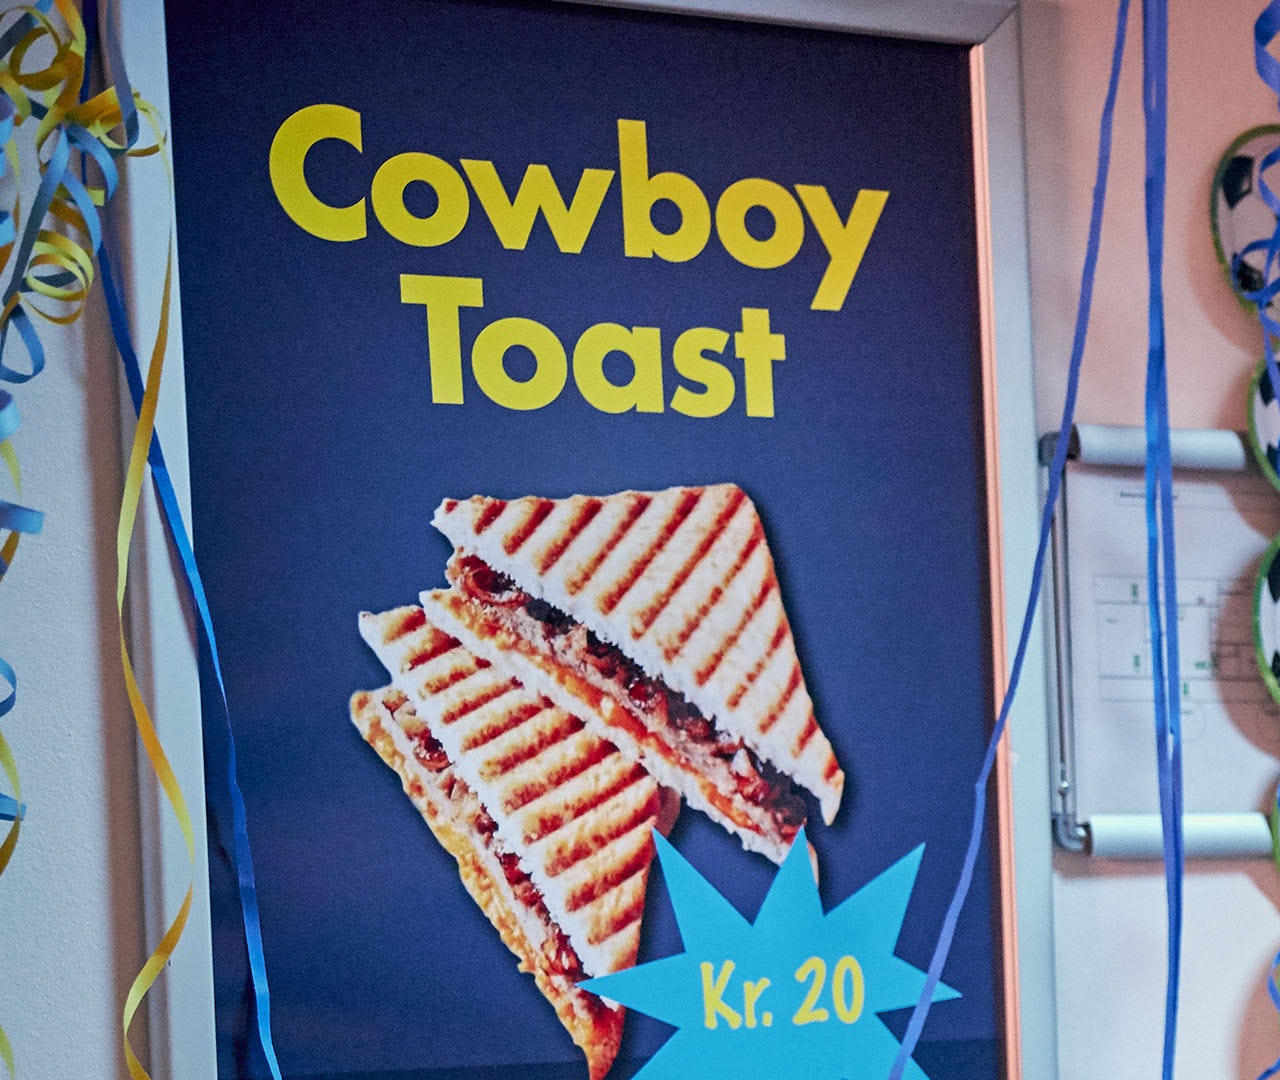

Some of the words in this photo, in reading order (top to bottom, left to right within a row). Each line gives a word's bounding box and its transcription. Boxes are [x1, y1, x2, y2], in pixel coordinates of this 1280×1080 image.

[269, 103, 889, 311] Cowboy
[399, 273, 786, 417] Toast
[700, 960, 773, 1030] Kr.
[792, 955, 865, 1025] 20
